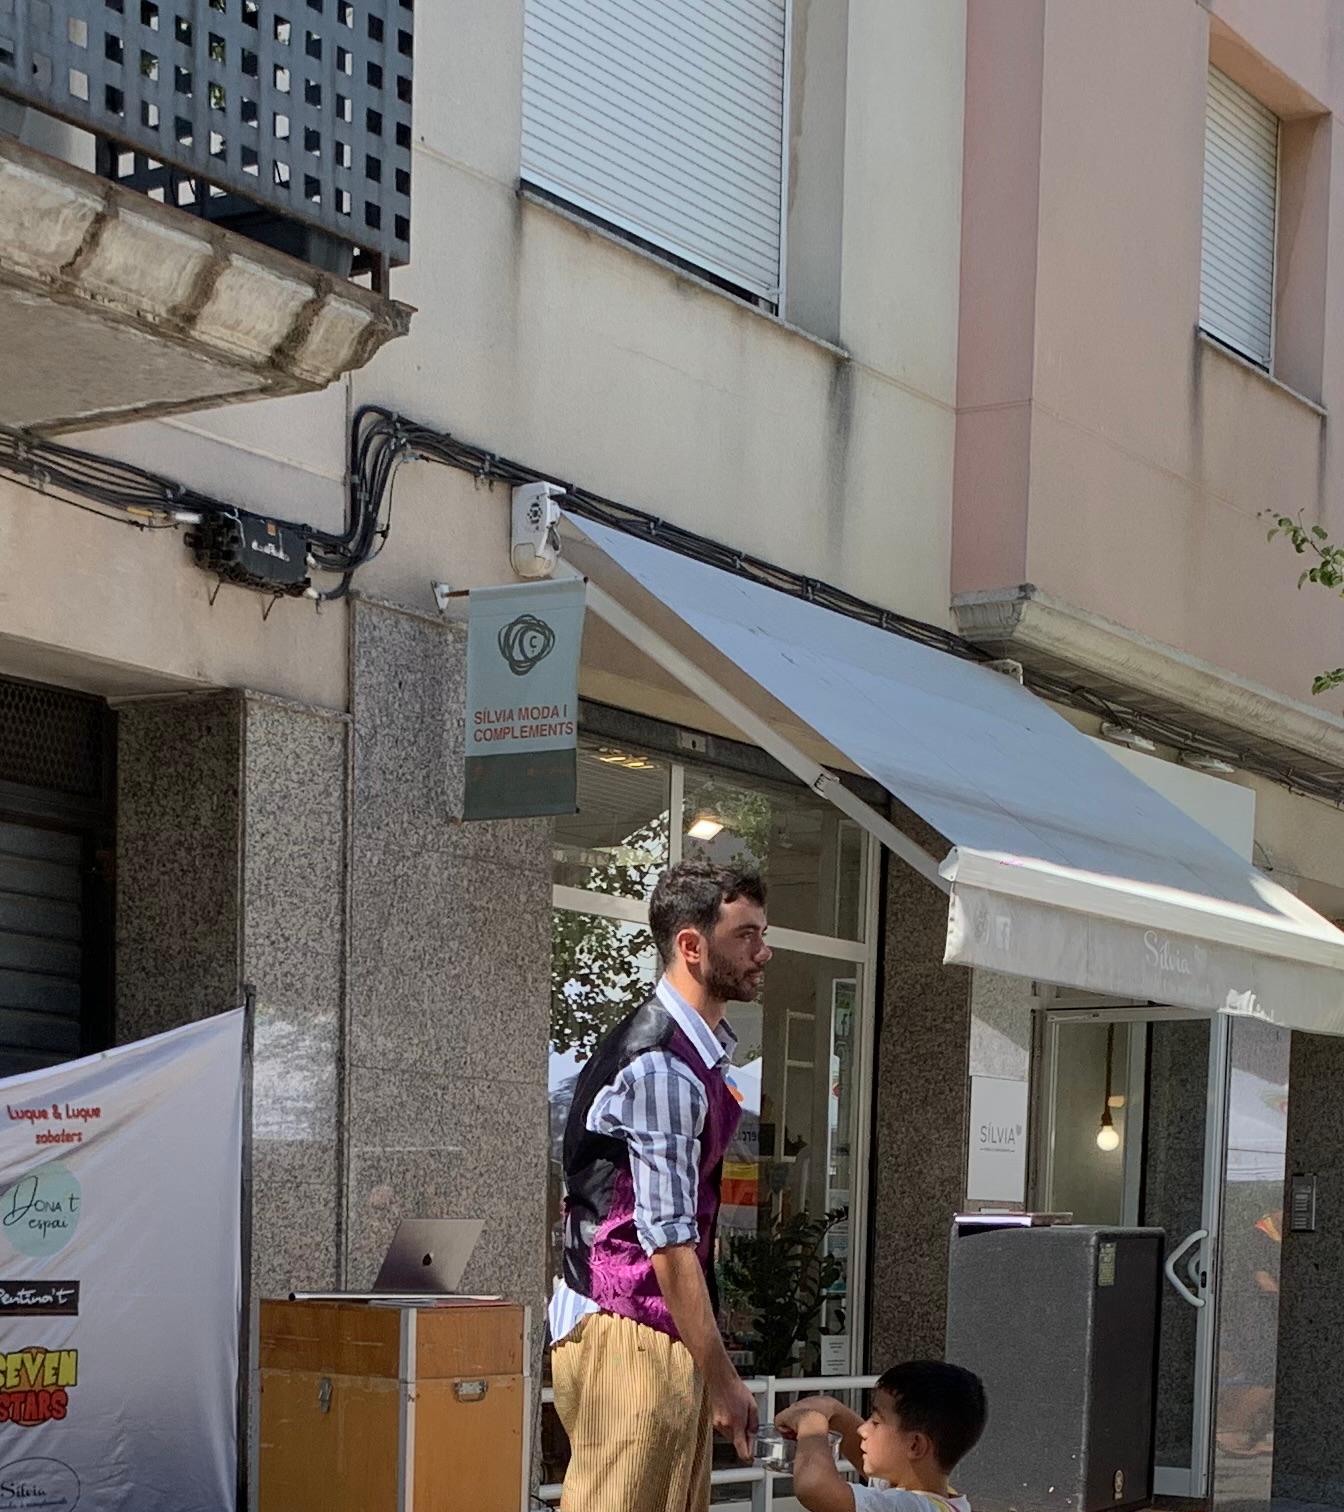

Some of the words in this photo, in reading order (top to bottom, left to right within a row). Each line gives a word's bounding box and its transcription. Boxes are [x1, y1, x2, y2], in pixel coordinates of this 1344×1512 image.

[518, 704, 560, 721] MODA
[563, 703, 568, 718] I
[473, 721, 574, 742] COMPLEMENTS
[7, 1104, 48, 1125] Luque
[52, 1103, 63, 1121] &
[66, 1104, 102, 1123] Luque
[28, 1218, 69, 1239] espai
